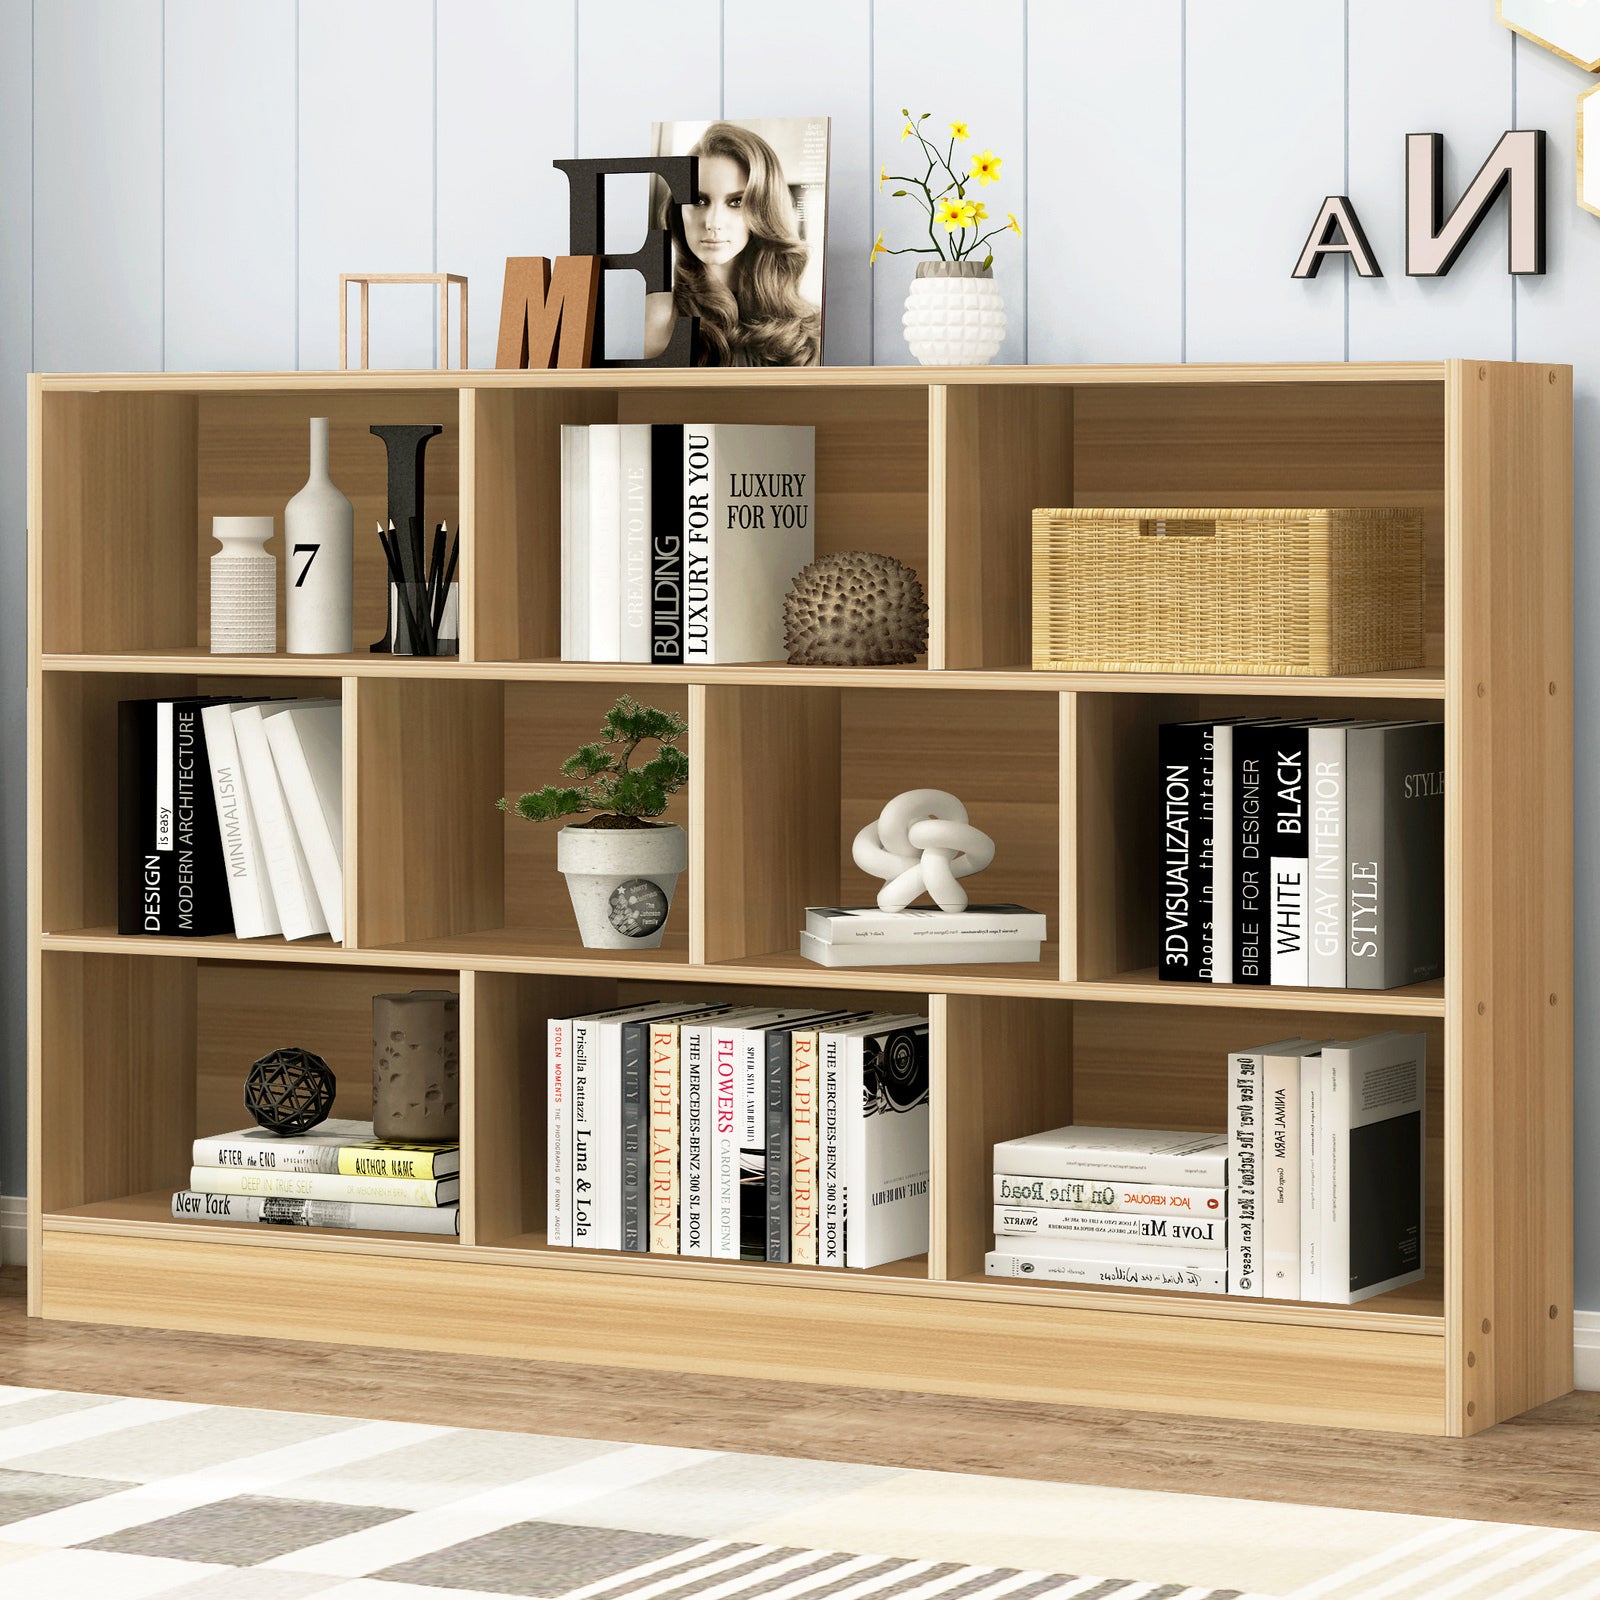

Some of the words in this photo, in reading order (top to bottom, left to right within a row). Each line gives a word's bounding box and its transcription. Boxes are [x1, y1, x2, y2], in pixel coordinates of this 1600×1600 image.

[552, 155, 701, 368] E
[1290, 195, 1384, 279] A
[495, 255, 599, 369] M
[688, 433, 709, 486] YOU
[628, 467, 644, 517] LIVE
[730, 473, 806, 497] LUXURY
[628, 519, 643, 543] TO
[688, 493, 709, 544] FOR
[727, 504, 765, 529] FOR
[770, 504, 808, 529] YOU
[292, 543, 321, 587] 7
[627, 553, 643, 628] CREATE
[654, 535, 680, 657] BUILDING
[688, 551, 708, 655] LUXURY
[179, 712, 194, 845] ARCHITECTURE
[1199, 731, 1214, 820] interior
[1277, 751, 1302, 833] BLACK
[159, 807, 171, 834] easy
[217, 766, 248, 878] MINIMALISM
[1243, 758, 1260, 859] DESIGNER
[1315, 761, 1340, 880] INTERIOR
[158, 836, 168, 845] is
[1166, 765, 1189, 931] VISUALIZATION
[1199, 837, 1213, 868] the
[145, 855, 160, 931] DESIGN
[179, 850, 193, 929] MODERN
[1199, 887, 1213, 903] in
[1242, 870, 1259, 910] FOR
[1277, 872, 1300, 954] WHITE
[1351, 861, 1378, 957] STYLE
[1314, 889, 1339, 956] GRAY
[1165, 934, 1188, 966] 3D
[1199, 922, 1213, 978] Doors
[1242, 922, 1259, 976] BIBLE
[554, 1026, 562, 1058] STOLEN
[576, 1028, 587, 1073] Priscilla
[690, 1034, 700, 1060] THE
[826, 1041, 836, 1068] THE
[554, 1063, 562, 1103] MOMENTS
[654, 1031, 671, 1117] RALPH
[717, 1039, 734, 1134] FLOWERS
[795, 1039, 811, 1123] RALPH
[576, 1077, 587, 1122] Rattazzi
[690, 1064, 700, 1171] MERCEDES-BENZ
[826, 1072, 837, 1178] MERCEDES-BENZ
[218, 1149, 243, 1166] AFTER
[247, 1155, 257, 1167] the
[259, 1151, 275, 1168] END
[355, 1158, 387, 1175] AUTHOR
[391, 1160, 416, 1177] NAME
[576, 1130, 592, 1174] Luna
[720, 1138, 731, 1203] CAROLYNE
[241, 1176, 260, 1191] DEEP
[264, 1178, 273, 1191] IN
[275, 1178, 294, 1193] TRUE
[297, 1180, 313, 1194] SELF
[555, 1177, 561, 1185] OF
[576, 1178, 592, 1193] &
[653, 1128, 671, 1229] LAUREN
[690, 1174, 700, 1192] 300
[690, 1195, 700, 1209] SL
[795, 1137, 811, 1240] LAUREN
[826, 1181, 837, 1201] 300
[175, 1193, 201, 1213] New
[205, 1195, 231, 1215] York
[576, 1199, 592, 1237] Lola
[826, 1205, 836, 1219] SL
[690, 1213, 700, 1248] BOOK
[826, 1222, 837, 1259] BOOK
